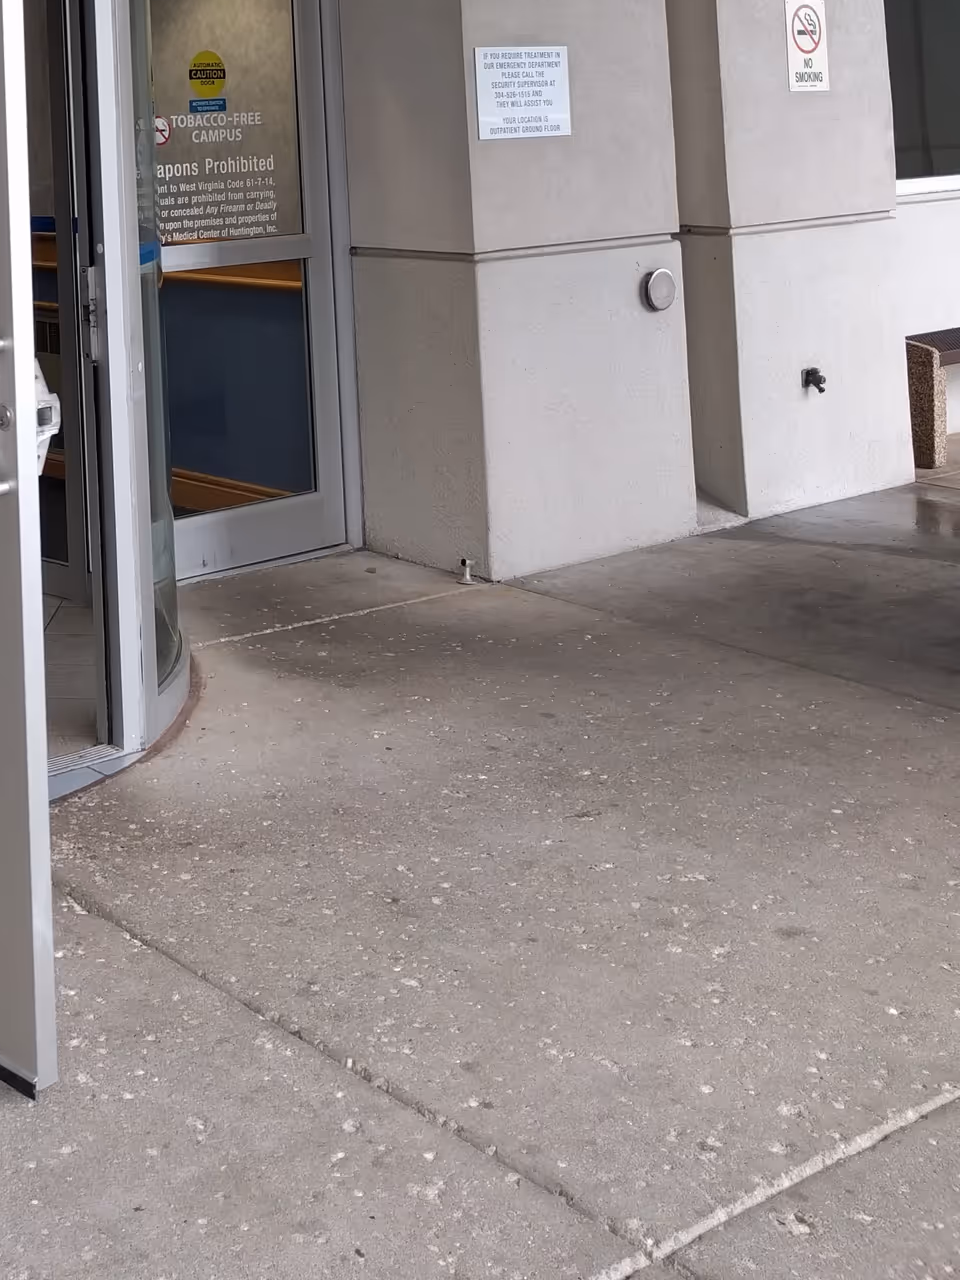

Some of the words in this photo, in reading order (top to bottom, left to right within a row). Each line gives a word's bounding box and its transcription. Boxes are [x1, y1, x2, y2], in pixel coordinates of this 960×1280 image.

[490, 52, 500, 60] YOU
[501, 52, 523, 60] REQUIRE
[484, 62, 494, 70] OUR
[804, 58, 813, 68] NO
[191, 70, 224, 79] CAUTION
[536, 70, 544, 78] THE
[795, 72, 823, 82] SMOKING
[516, 80, 548, 88] SUPERVISOR
[496, 100, 509, 108] THEY
[510, 100, 522, 108] WILL
[170, 112, 262, 128] TOBACCO-FREE
[502, 116, 516, 124] YOUR
[518, 116, 542, 124] LOCATION
[192, 128, 242, 143] CAMPUS
[156, 162, 198, 180] apons
[205, 154, 274, 174] Prohibited
[170, 184, 178, 193] to
[180, 182, 196, 191] West
[198, 180, 225, 192] Virginia
[227, 179, 244, 188] Code
[178, 196, 188, 204] are
[192, 192, 226, 205] prohibited
[228, 192, 244, 200] from
[162, 210, 168, 218] or
[170, 206, 204, 217] concealed
[206, 206, 218, 216] Any
[220, 203, 245, 213] Firearm
[256, 200, 278, 211] Deadly
[165, 221, 182, 231] upon
[183, 219, 194, 228] the
[194, 218, 224, 229] premises
[225, 216, 237, 225] and
[238, 214, 269, 226] properties
[270, 212, 278, 220] of
[172, 230, 198, 241] Medical
[199, 229, 220, 239] Center
[222, 228, 228, 236] of
[266, 224, 278, 233] Inc.
